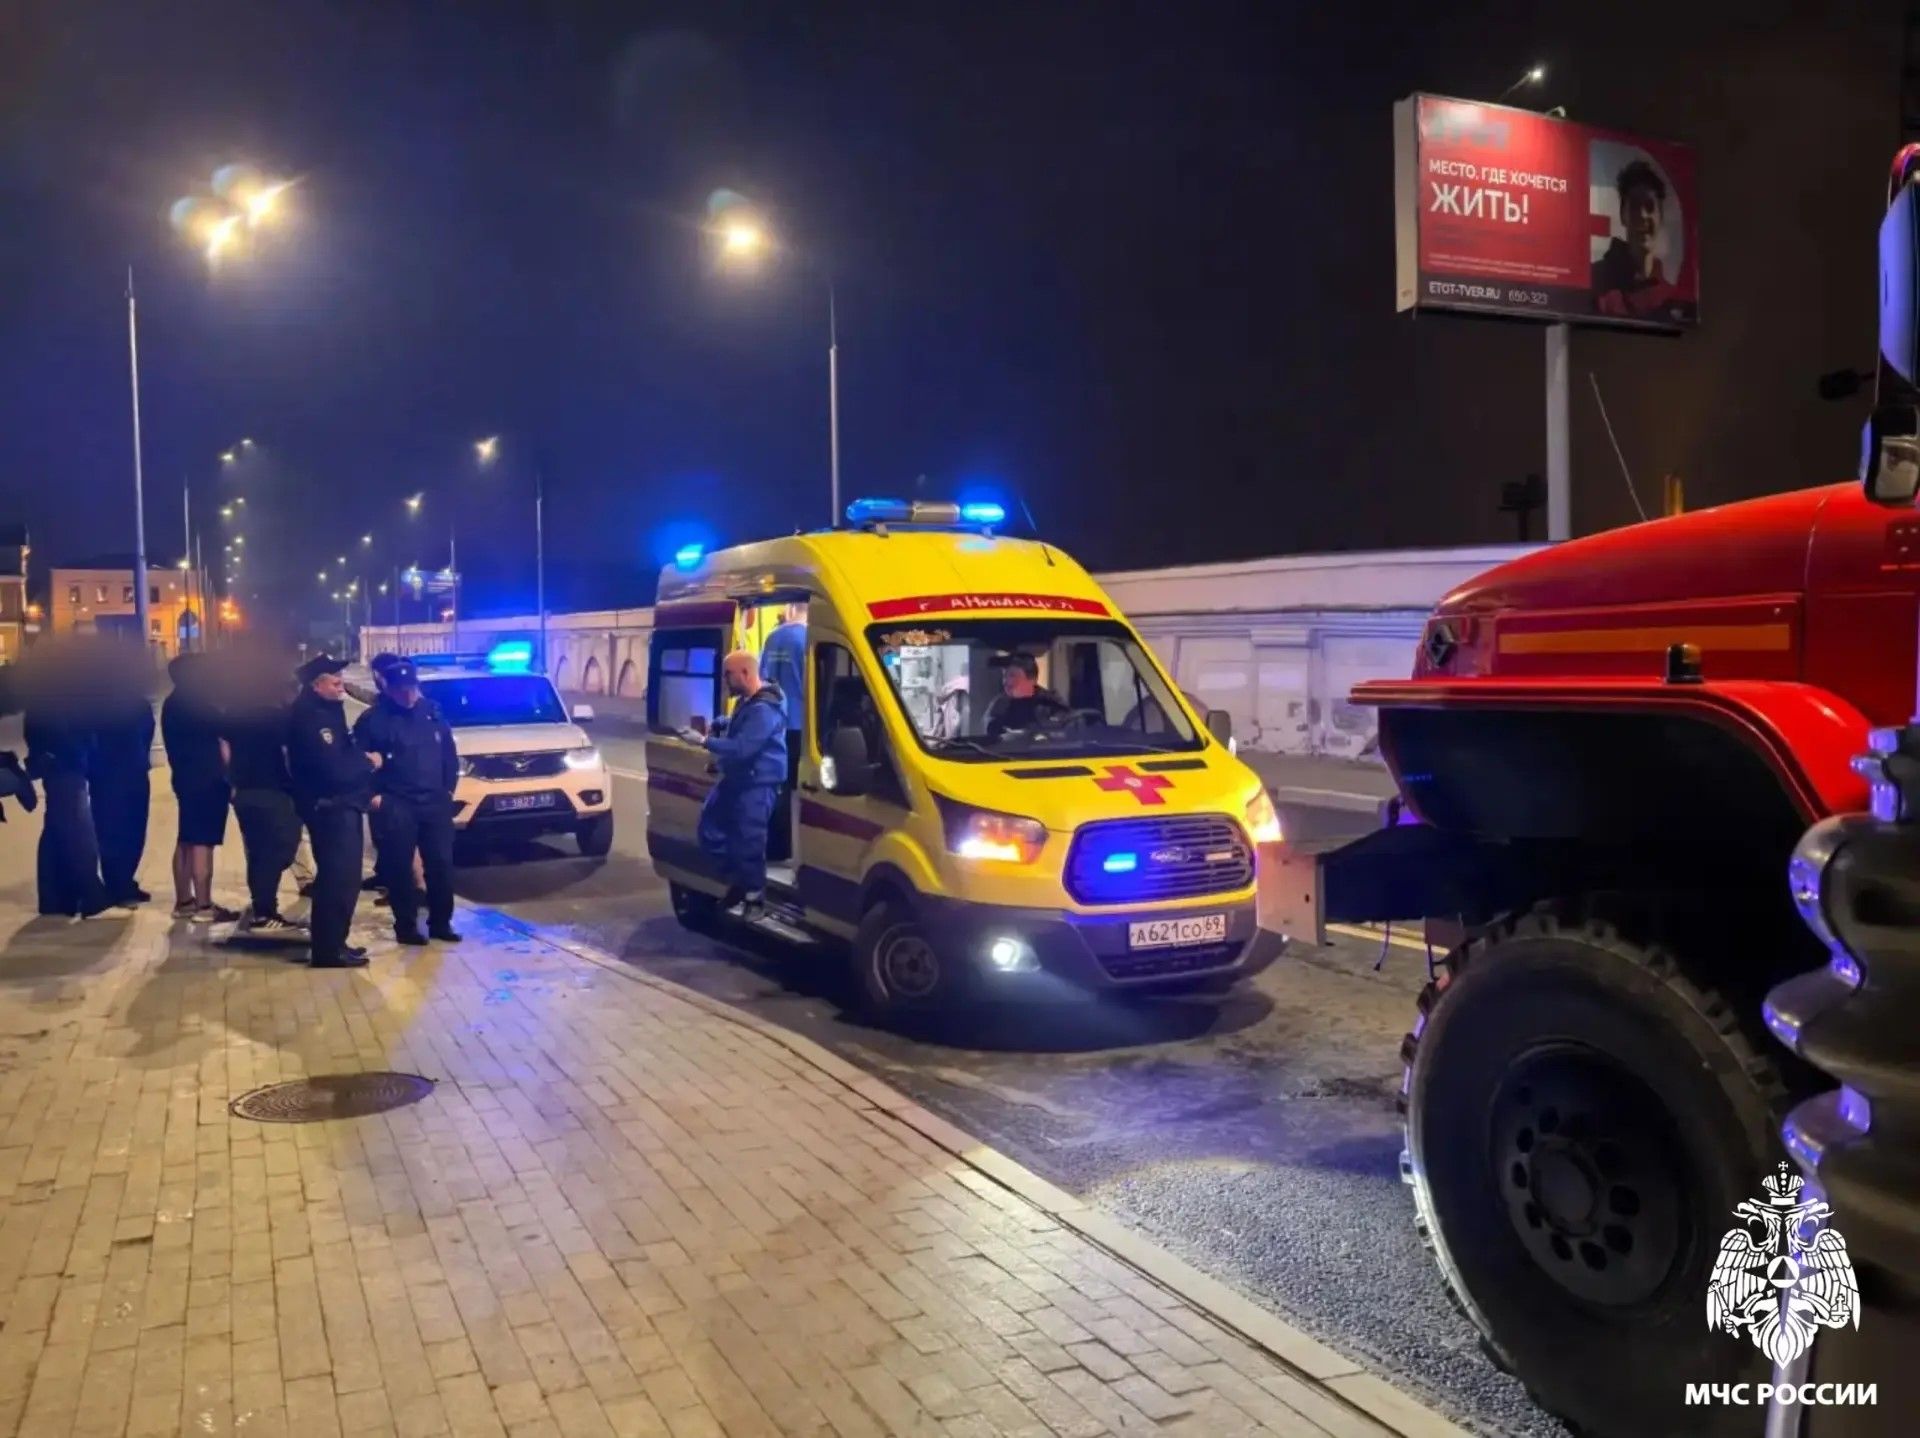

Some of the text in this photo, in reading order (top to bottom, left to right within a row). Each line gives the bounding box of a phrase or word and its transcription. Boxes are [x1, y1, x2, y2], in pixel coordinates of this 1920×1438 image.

[1482, 167, 1507, 184] ГДЕ
[1510, 170, 1567, 192] ХОЧЕТСЯ
[1430, 182, 1529, 224] ЖИТЬ!
[1429, 281, 1500, 299] ETOT-TVER.RU
